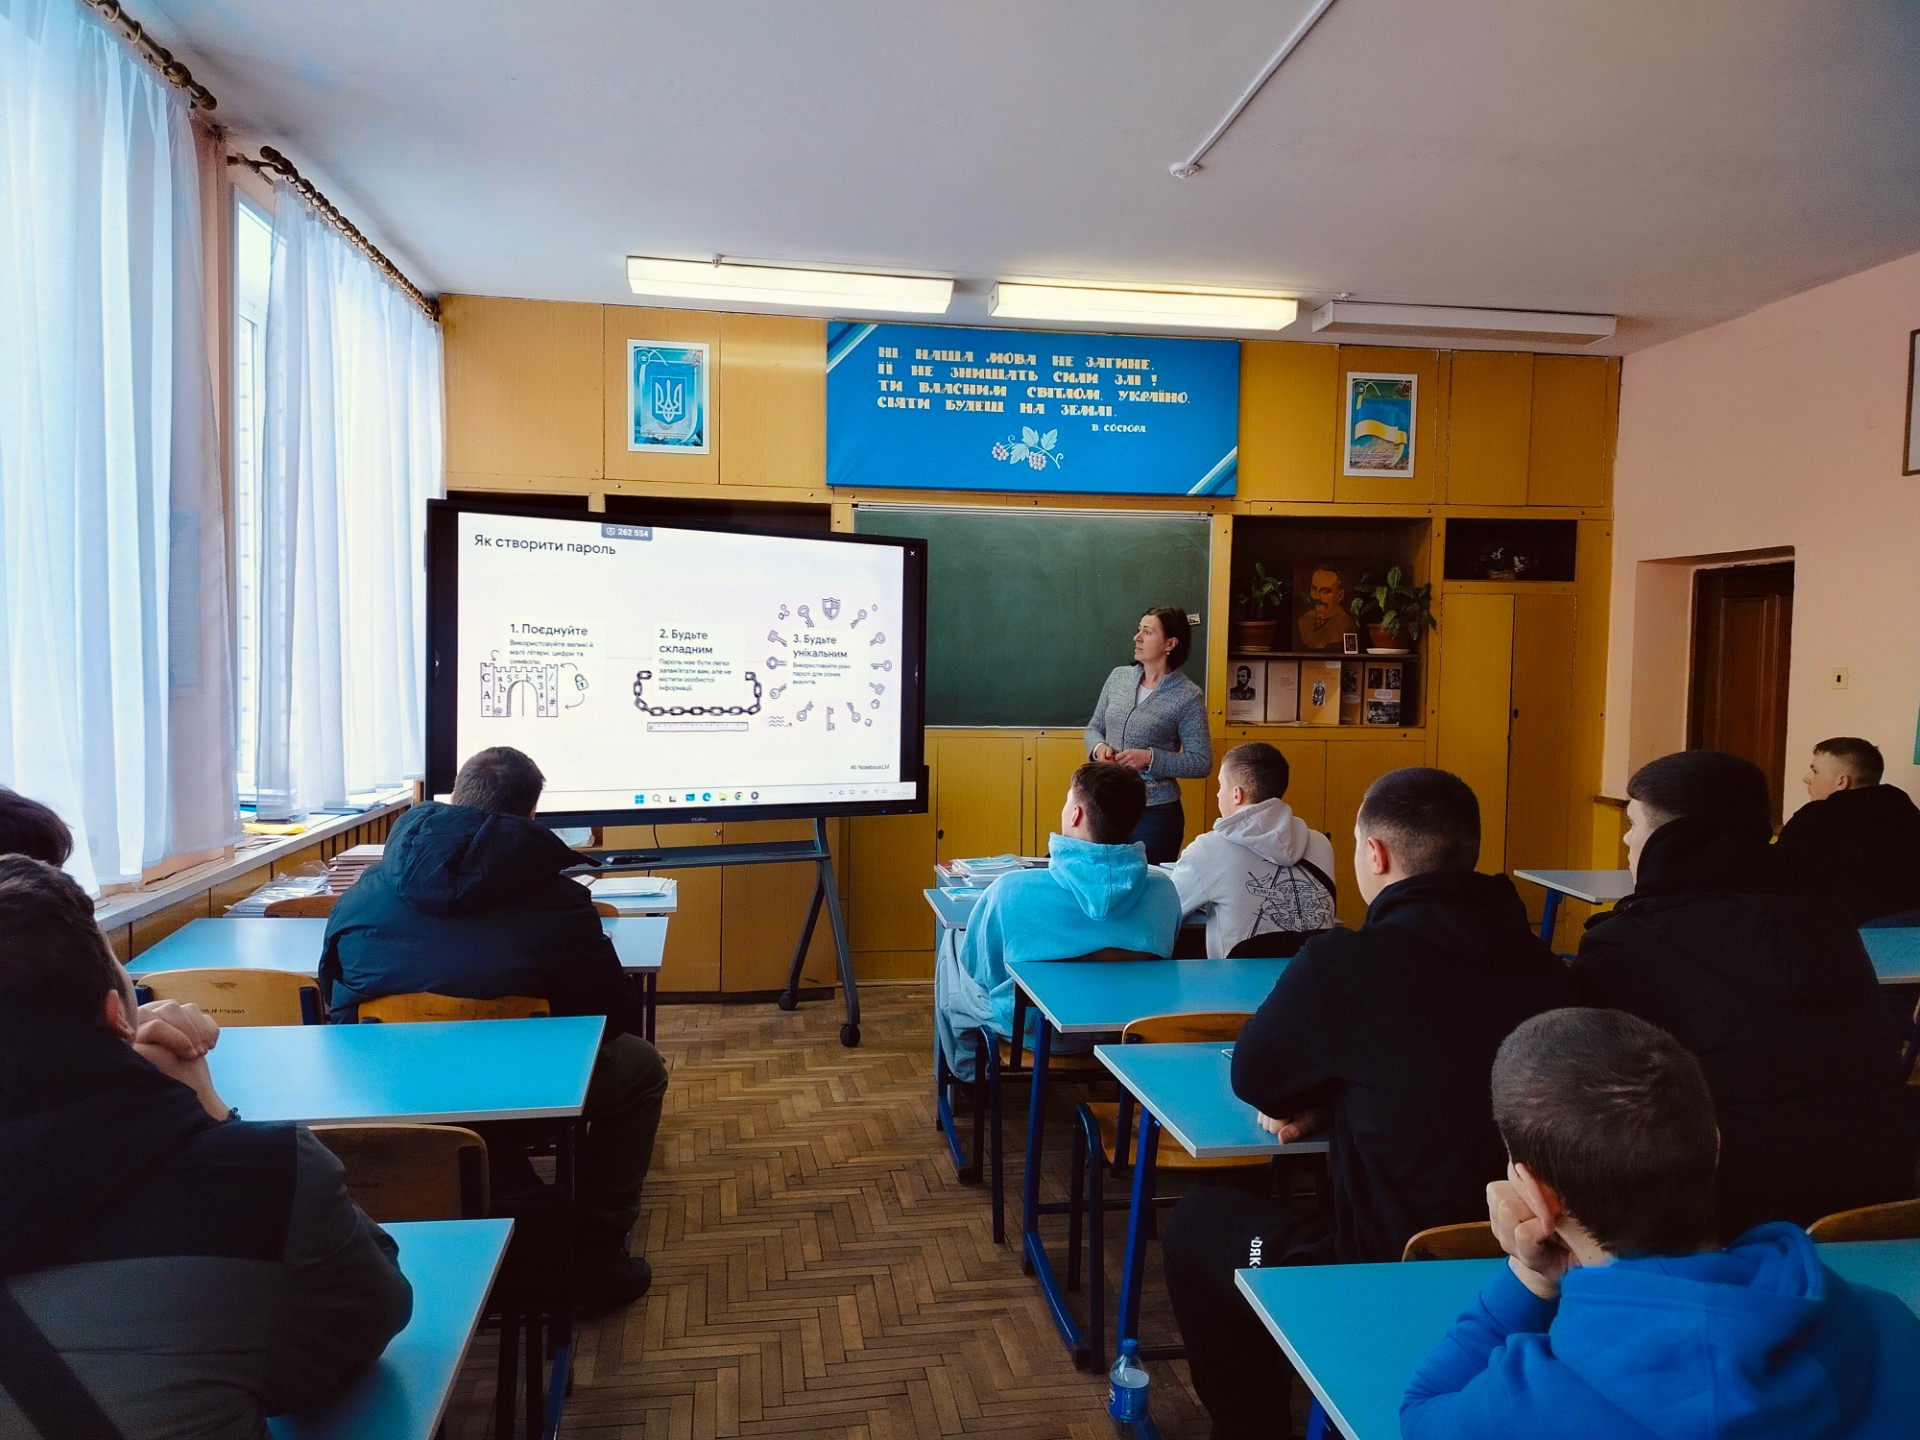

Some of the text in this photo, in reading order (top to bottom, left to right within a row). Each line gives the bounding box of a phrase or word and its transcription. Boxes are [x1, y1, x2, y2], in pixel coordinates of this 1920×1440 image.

[915, 348, 974, 362] НАША
[986, 352, 1037, 365] МОВА
[1052, 355, 1074, 367] НЕ
[877, 361, 893, 375] ЇЇ
[911, 365, 934, 377] НЕ
[1053, 371, 1099, 384] СИЛИ
[1114, 373, 1141, 386] ЗЛІ
[878, 380, 903, 392] ТИ
[919, 381, 1007, 397] ВЛАСНИМ
[877, 396, 931, 410] СІЯТИ
[945, 399, 1005, 413] БУДЕШ
[1020, 402, 1045, 415] НА
[1103, 423, 1147, 433] СОСЮРА
[617, 528, 649, 538] 262 554
[474, 534, 616, 556] Як створити пароль
[510, 623, 588, 638] 1. Поєднуйте
[659, 628, 708, 641] 2. Будьте
[510, 639, 566, 648] Використовуйте
[793, 633, 837, 645] 3. Будьте
[659, 645, 713, 655] складним
[793, 648, 847, 659] унікальним
[659, 658, 682, 666] Пароль
[1253, 887, 1279, 897] POWER
